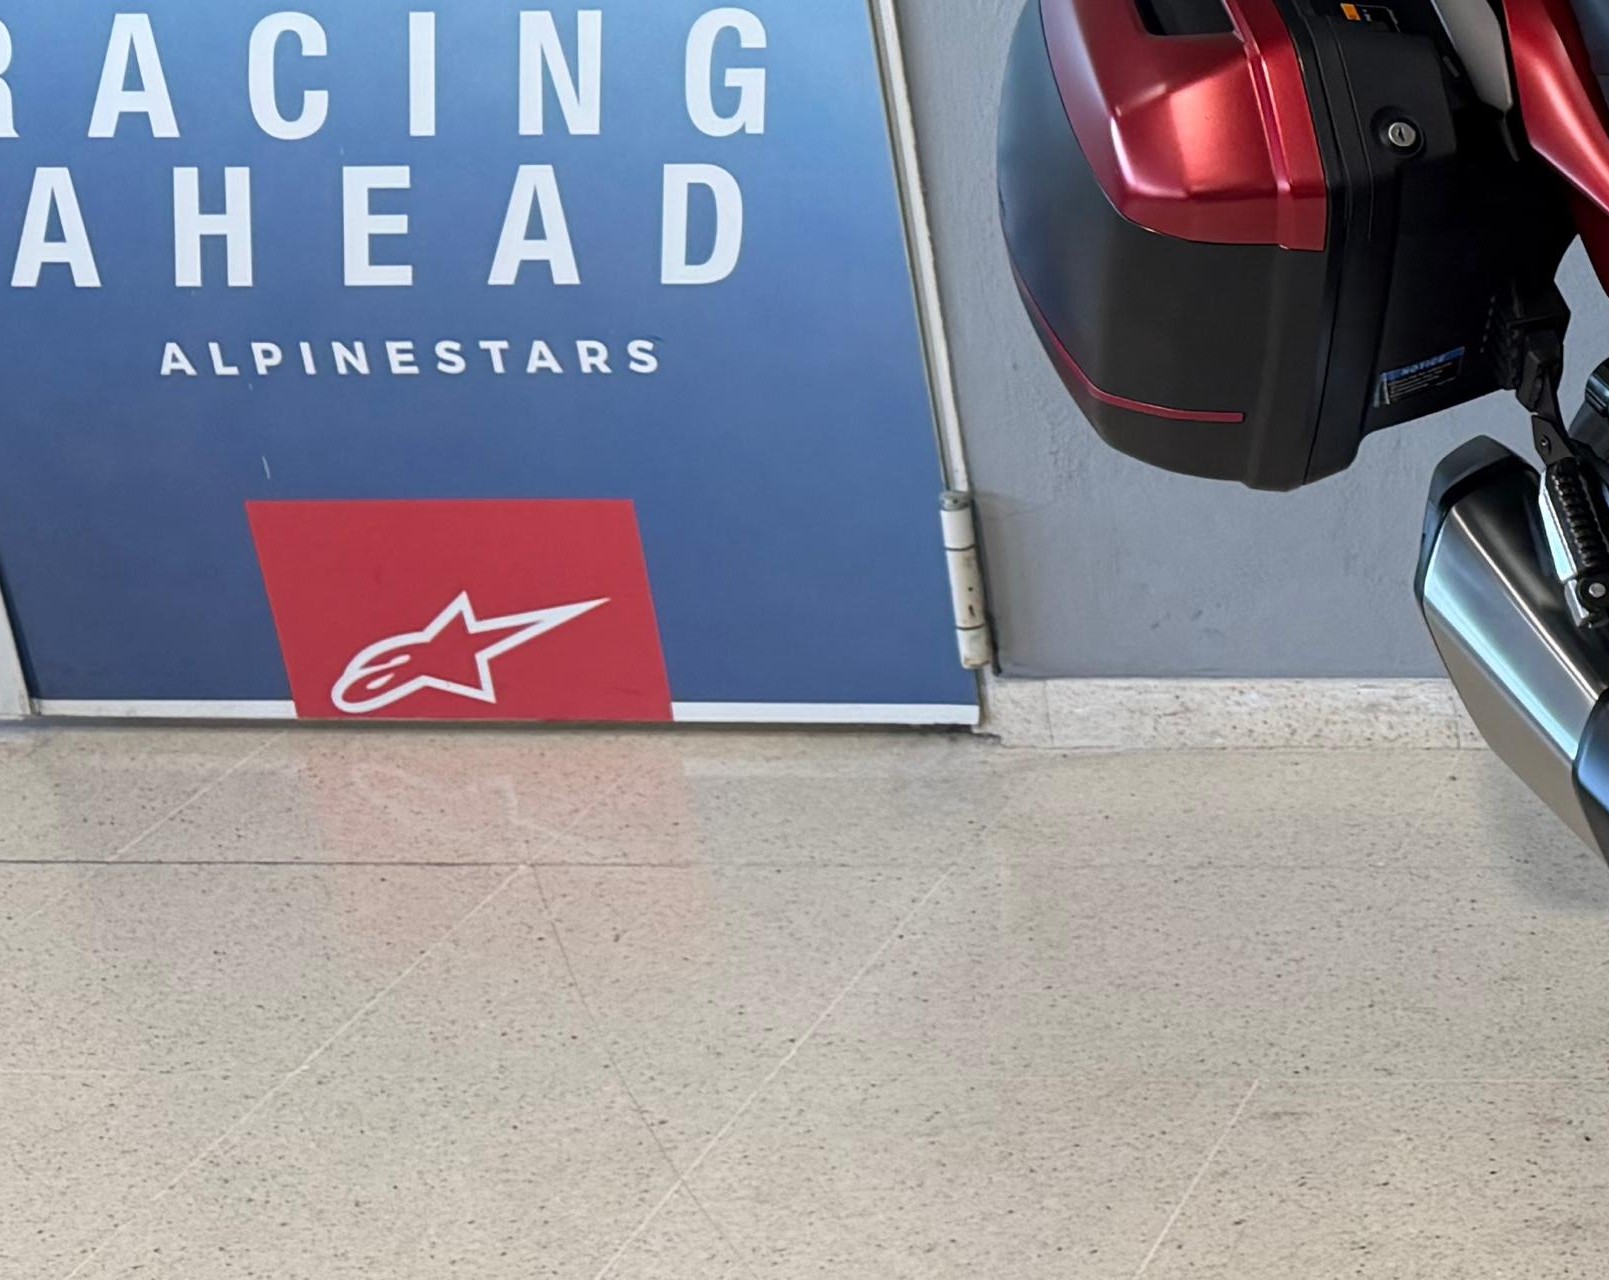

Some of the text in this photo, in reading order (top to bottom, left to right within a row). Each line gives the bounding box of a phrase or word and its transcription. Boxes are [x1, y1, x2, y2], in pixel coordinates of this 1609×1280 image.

[0, 8, 768, 140] ACING
[11, 163, 744, 287] AHEAD
[161, 340, 660, 375] ALPINESTARS
